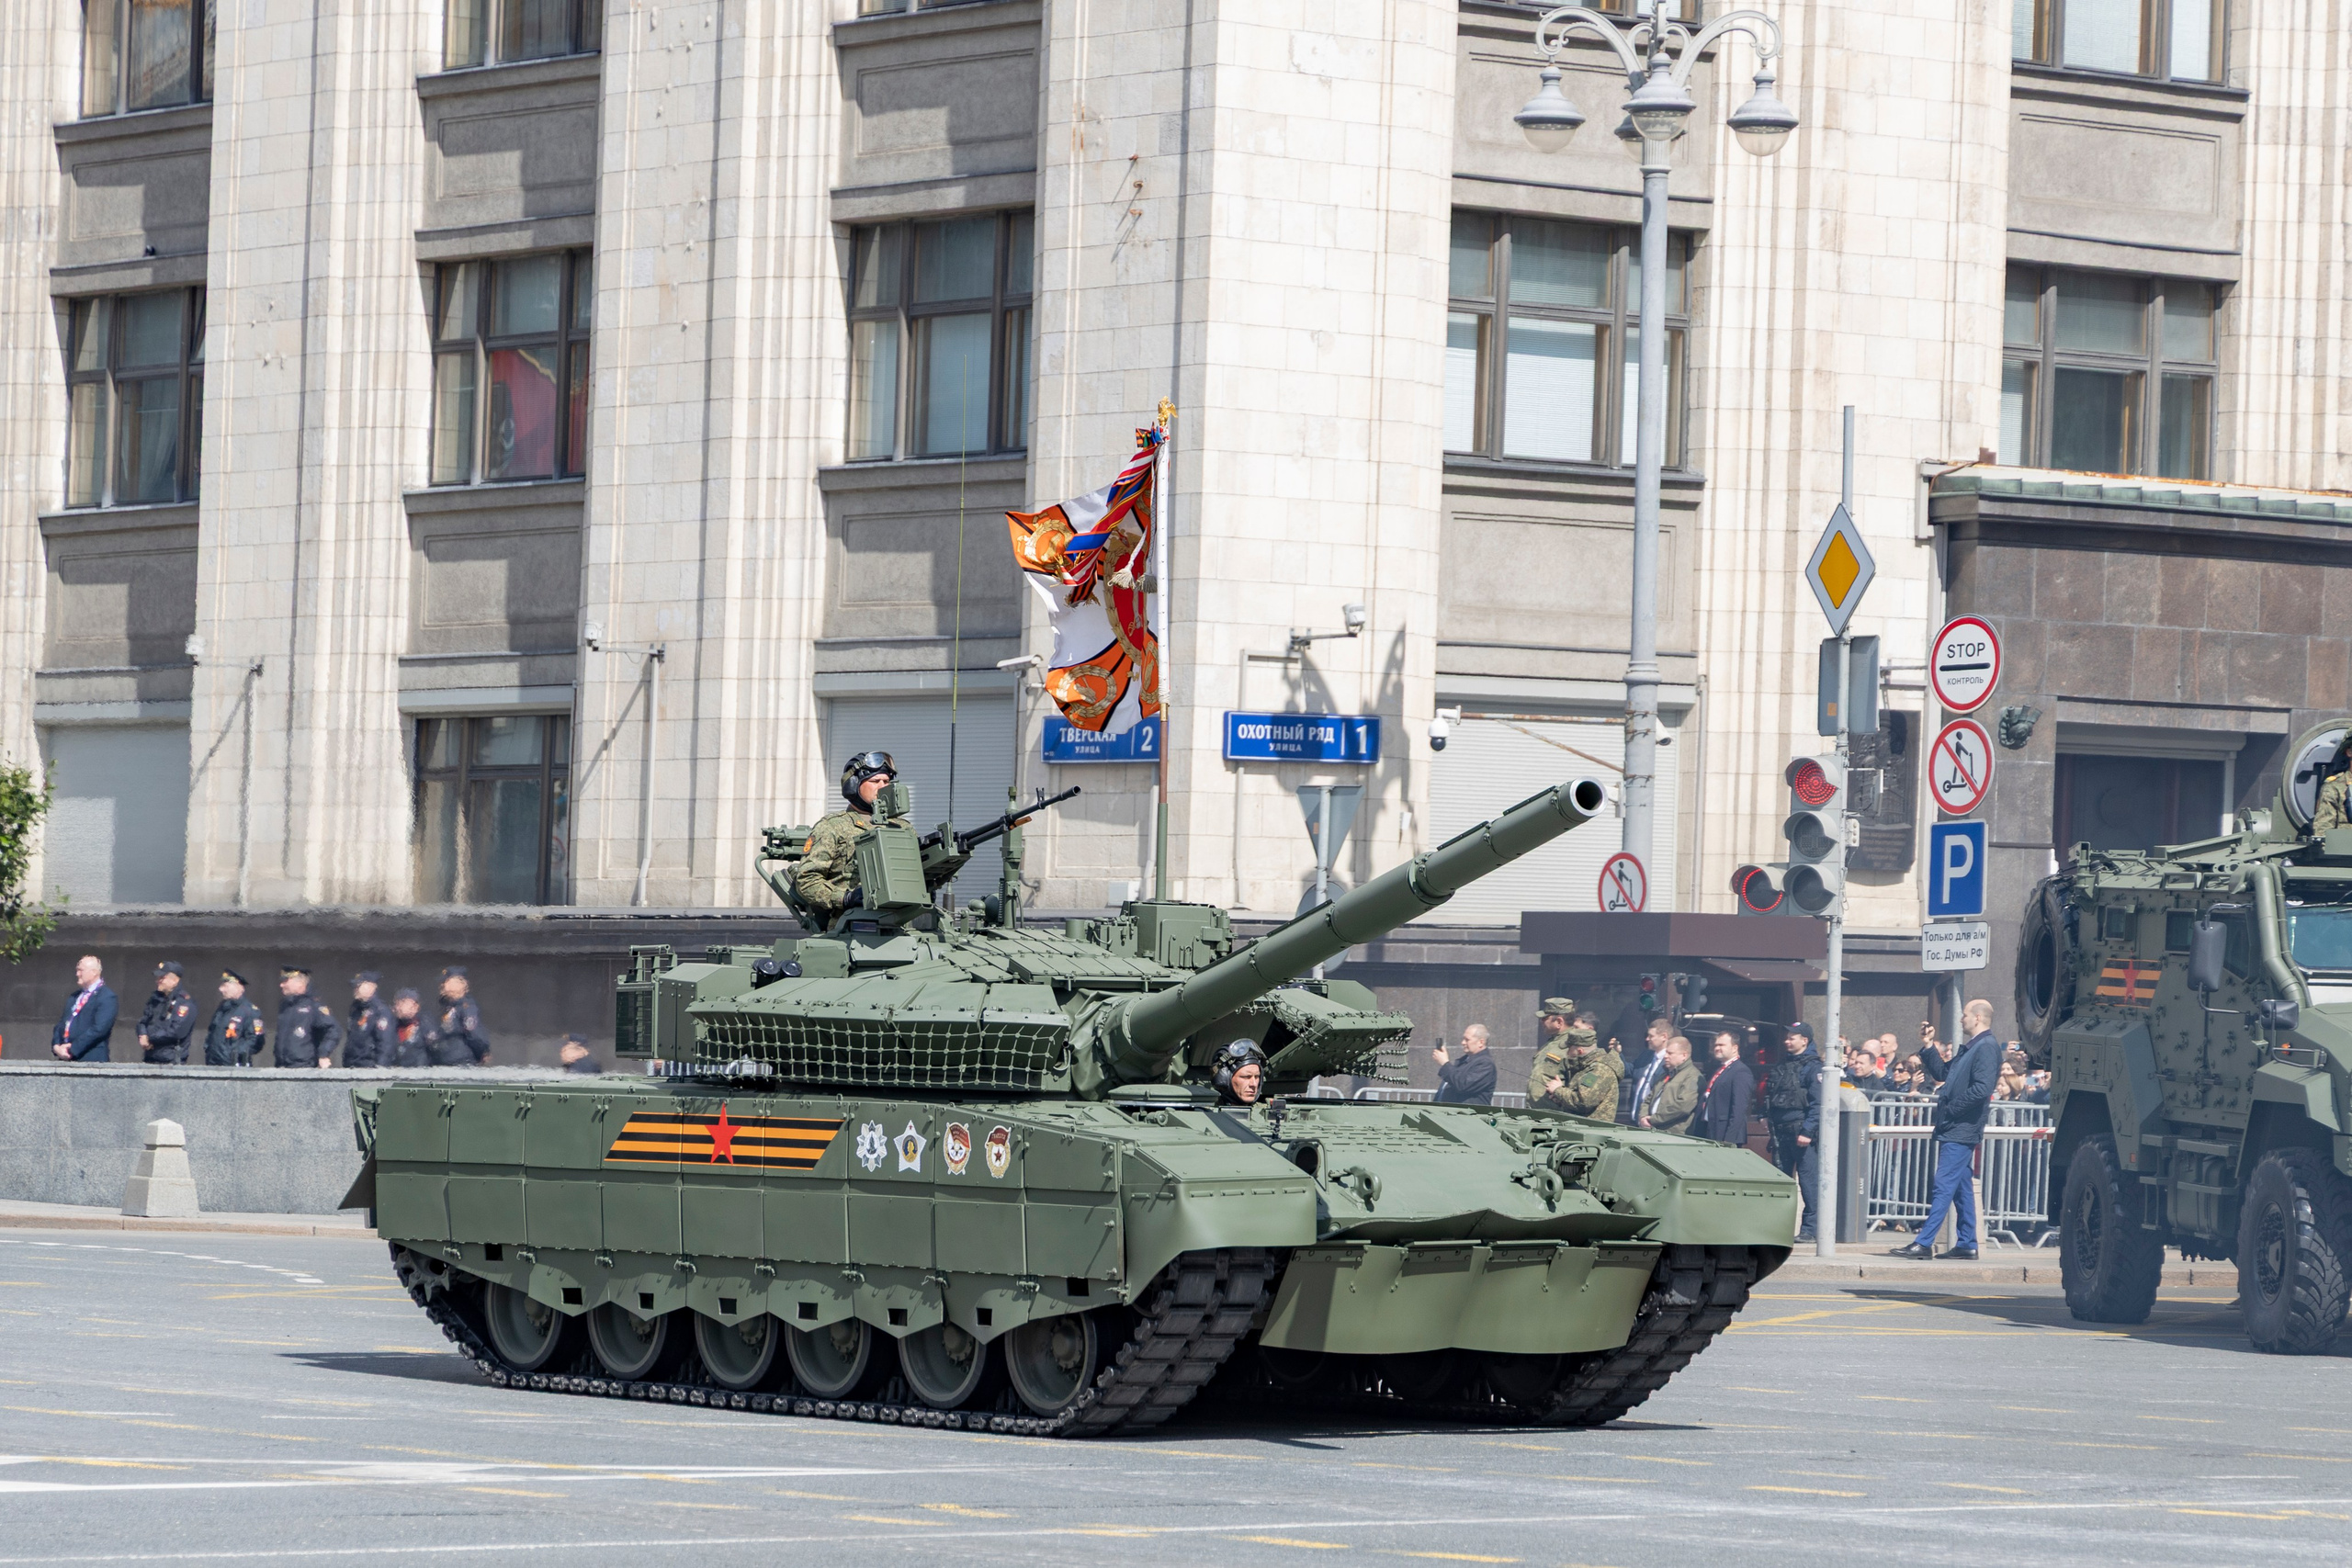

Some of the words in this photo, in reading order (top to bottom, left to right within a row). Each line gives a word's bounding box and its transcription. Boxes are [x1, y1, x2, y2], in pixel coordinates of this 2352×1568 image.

[1947, 642, 1986, 659] STOP
[1947, 676, 1984, 685] КОНТРОЛЬ
[1140, 726, 1153, 751] 2
[1238, 723, 1304, 741] ОХОТНЫЙ
[1308, 726, 1335, 743] РЯД
[1356, 724, 1368, 754] 1
[1074, 745, 1100, 754] УЛИЦА
[1269, 742, 1303, 751] УЛИЦА
[1942, 834, 1974, 904] P
[1924, 931, 1953, 942] Только
[1955, 931, 1972, 942] для
[1973, 929, 1986, 940] а/м
[1927, 950, 1943, 960] Гос.
[1944, 948, 1969, 962] Думы
[1971, 948, 1984, 958] РФ
